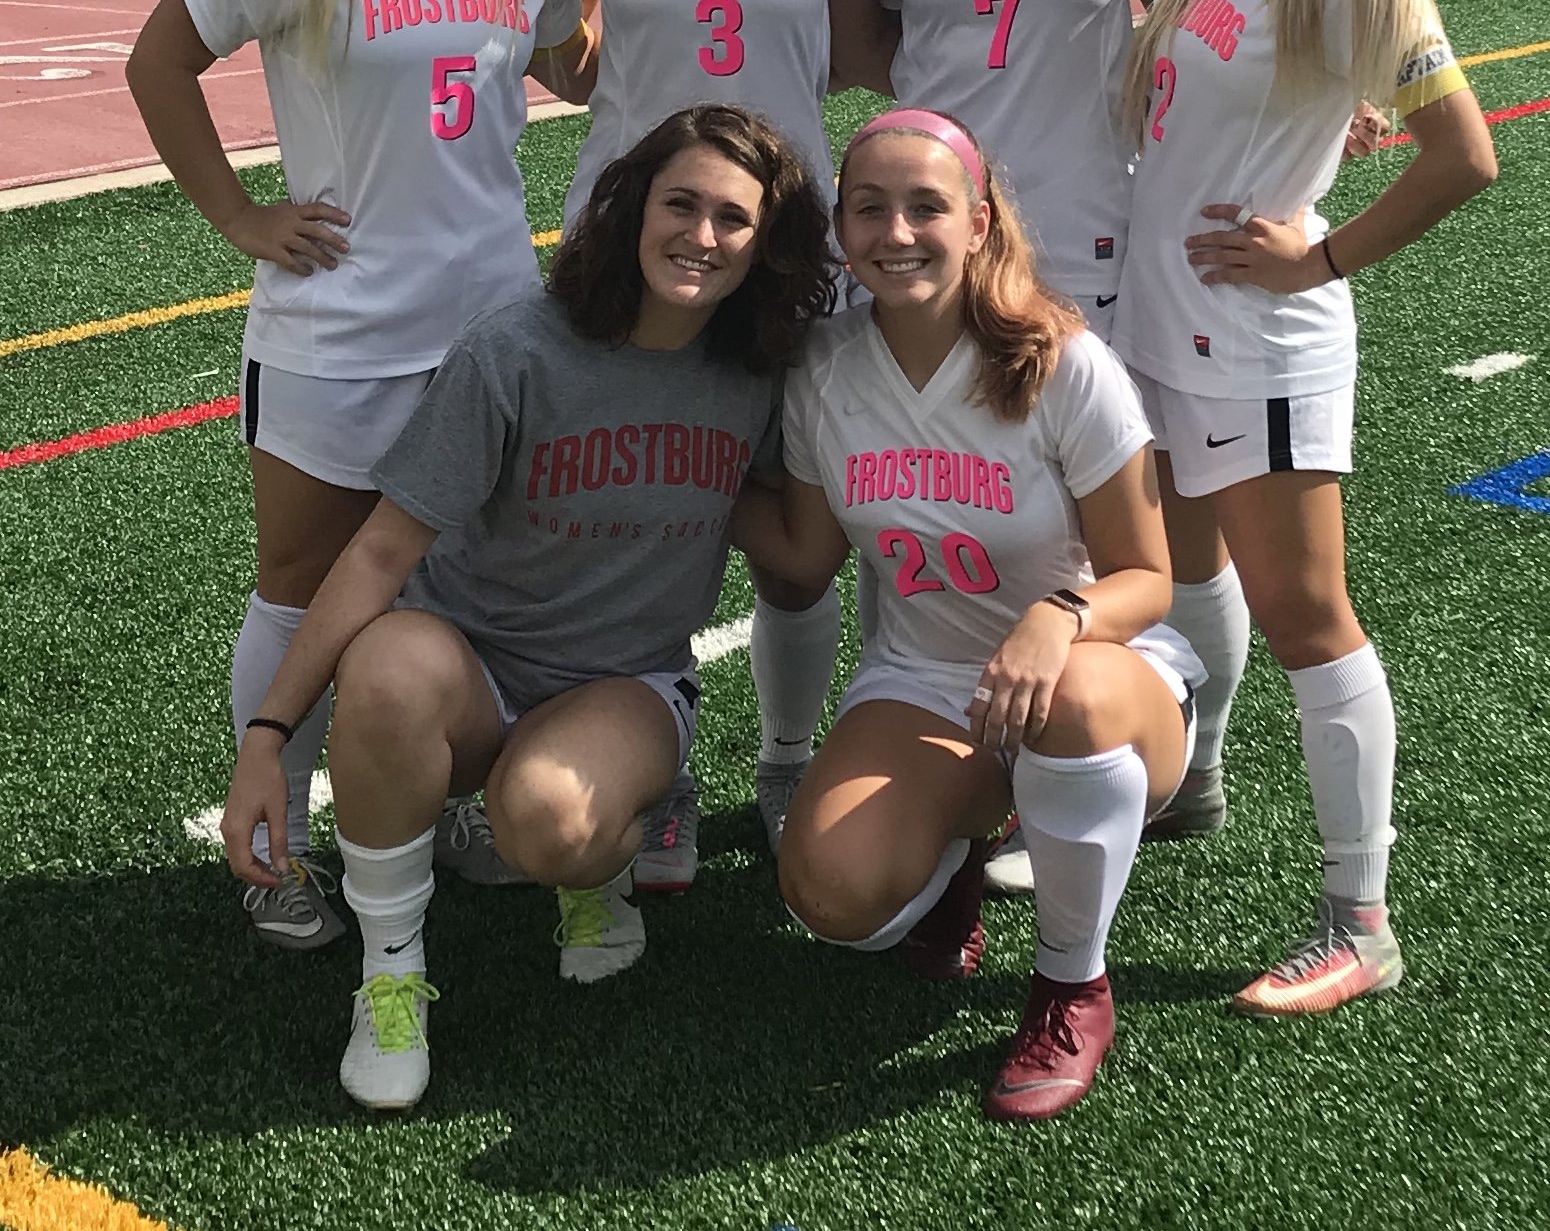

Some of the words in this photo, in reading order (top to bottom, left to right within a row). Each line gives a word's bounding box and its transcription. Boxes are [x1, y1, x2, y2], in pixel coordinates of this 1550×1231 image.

[430, 55, 477, 141] 5
[1151, 56, 1177, 144] 2
[1396, 48, 1451, 87] APTAIN
[845, 449, 1014, 514] FROSTBURG
[527, 510, 642, 539] WOMEN'S
[876, 529, 1000, 597] 20
